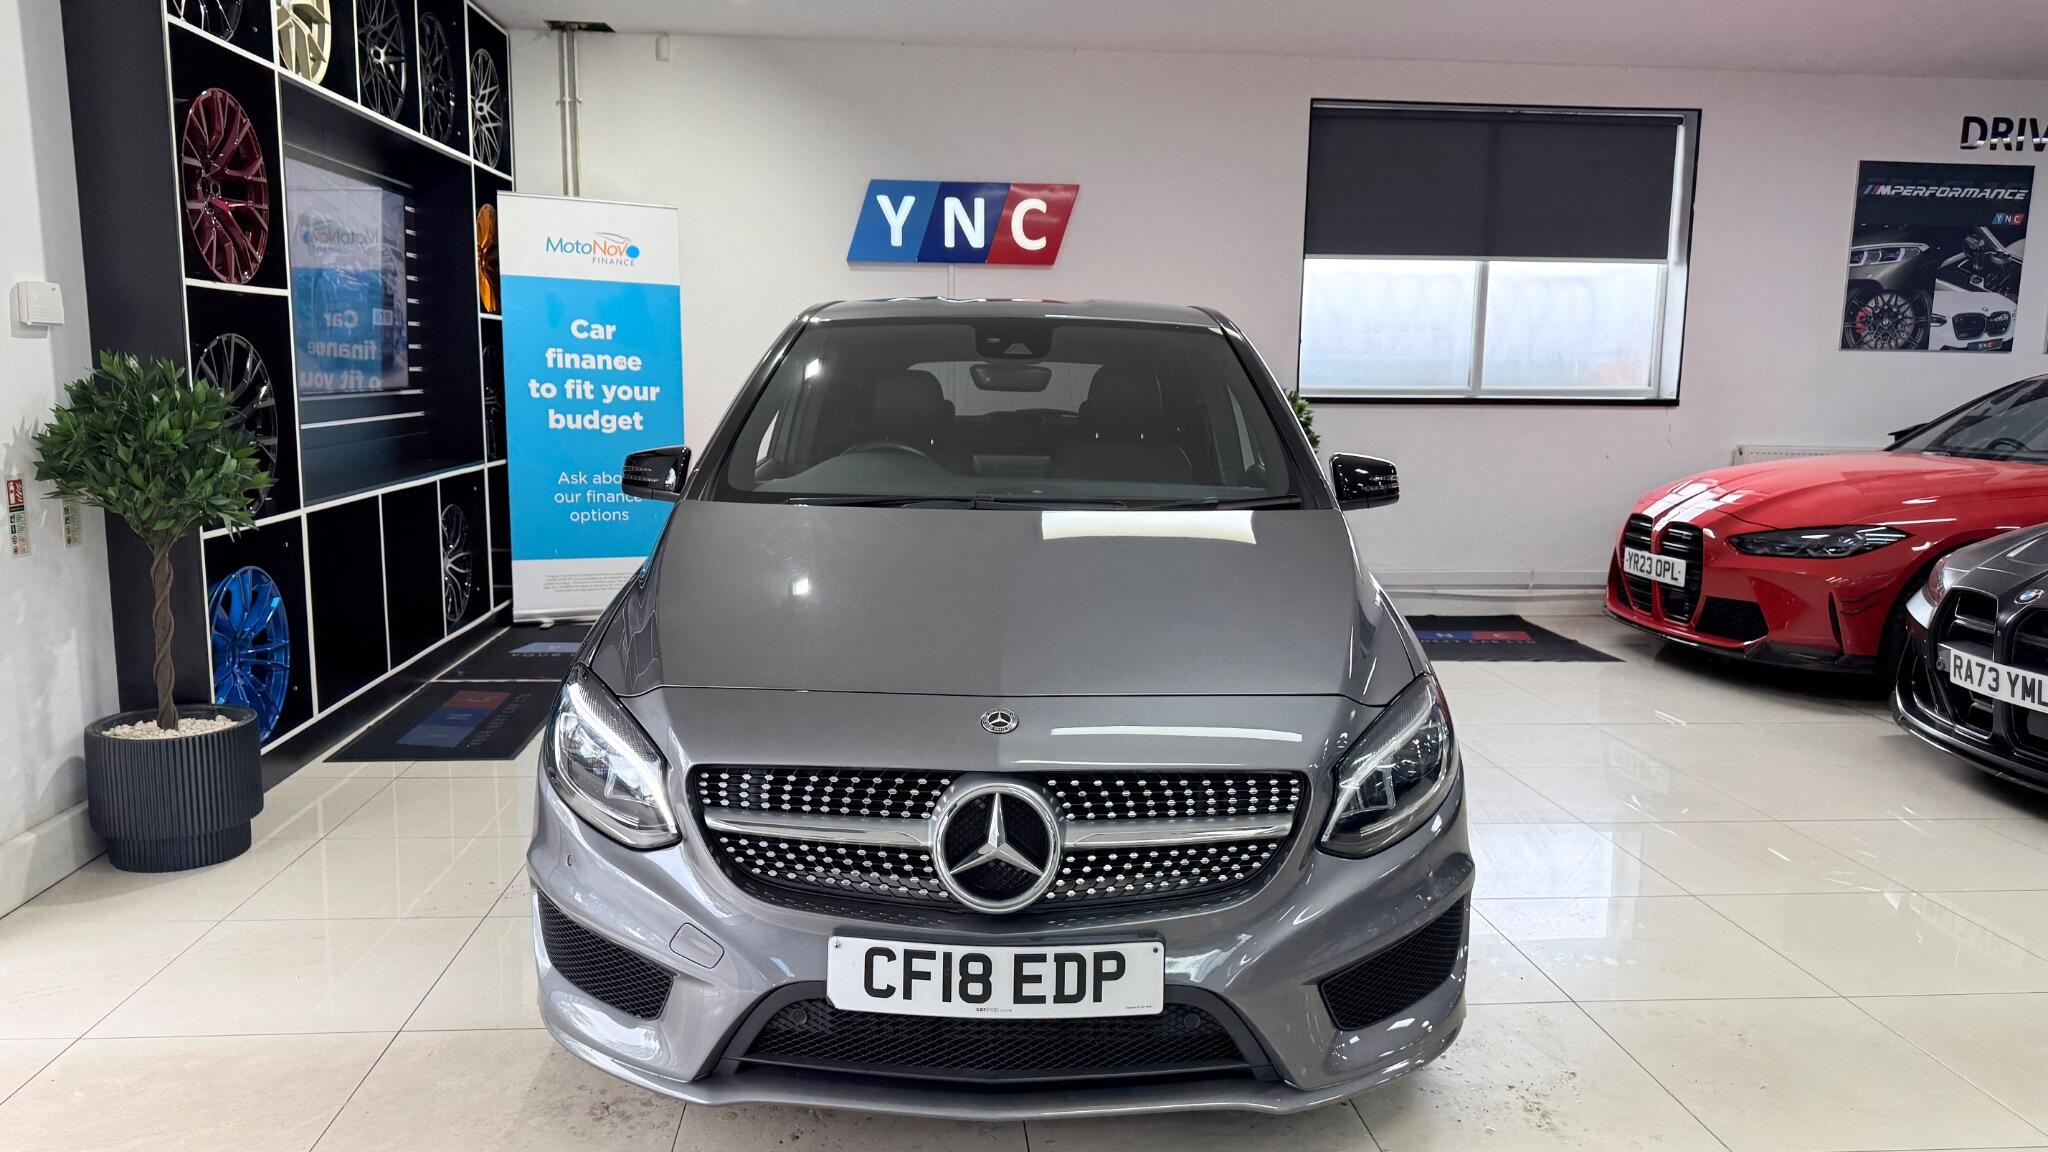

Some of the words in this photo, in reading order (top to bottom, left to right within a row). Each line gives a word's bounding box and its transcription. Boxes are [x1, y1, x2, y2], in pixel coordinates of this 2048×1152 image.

[876, 195, 1047, 250] YNC
[592, 256, 636, 267] FINANCE
[570, 319, 616, 340] Car
[545, 348, 642, 371] finance
[528, 379, 557, 398] to
[564, 379, 594, 399] fit
[601, 383, 660, 404] your
[548, 409, 643, 433] budget
[557, 471, 588, 484] Ask
[592, 471, 622, 484] abo
[554, 494, 579, 503] our
[569, 508, 629, 524] options
[1628, 551, 1653, 575] YR23
[1655, 559, 1679, 581] OPL
[1953, 654, 2000, 693] RA73
[2006, 671, 2048, 706] YML
[864, 946, 992, 1004] CF18
[1013, 950, 1127, 1005] EDP
